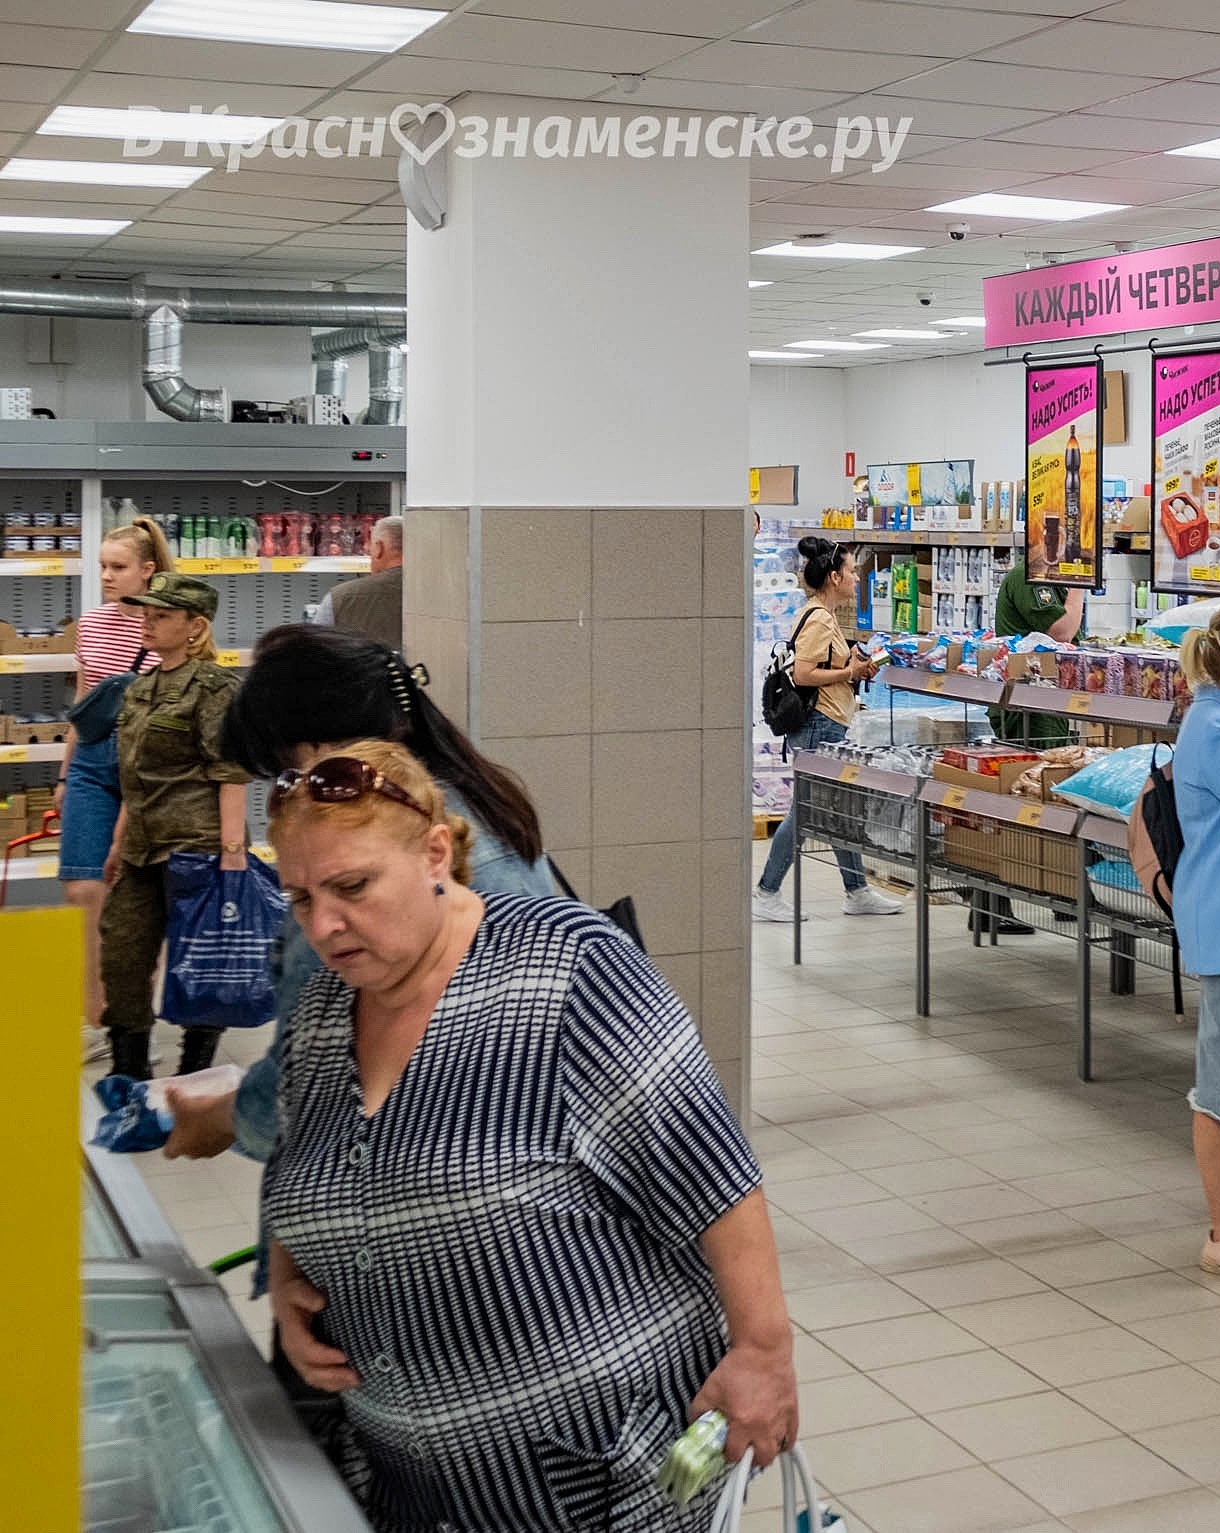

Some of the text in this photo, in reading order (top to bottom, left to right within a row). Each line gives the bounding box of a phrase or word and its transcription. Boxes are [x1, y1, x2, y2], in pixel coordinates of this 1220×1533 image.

[1015, 266, 1122, 327] КАЖДЫЙ
[1031, 378, 1093, 431] НАДО УСПЕТЬ!
[1159, 388, 1189, 422] НАДО
